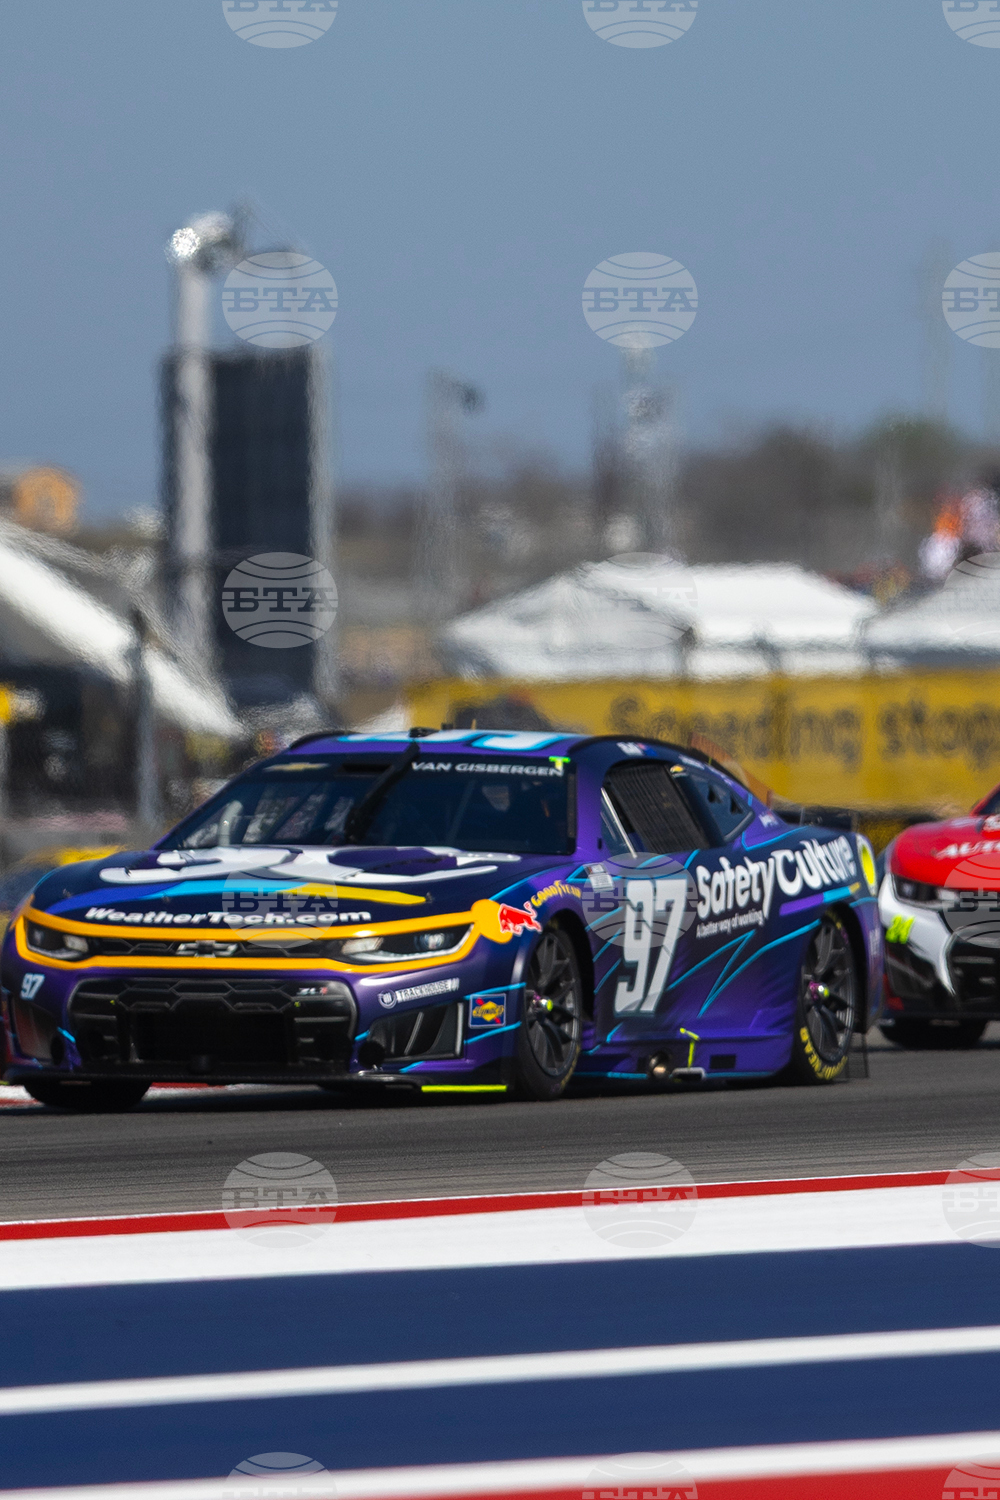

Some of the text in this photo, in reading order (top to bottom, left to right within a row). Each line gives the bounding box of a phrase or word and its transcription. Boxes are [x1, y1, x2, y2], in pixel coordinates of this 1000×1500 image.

[411, 762, 565, 777] VAN GISBERGEN
[696, 835, 857, 920] SafetyCulture
[84, 907, 371, 924] WeatherTech.com
[614, 877, 687, 1014] 97
[20, 973, 45, 1000] 97
